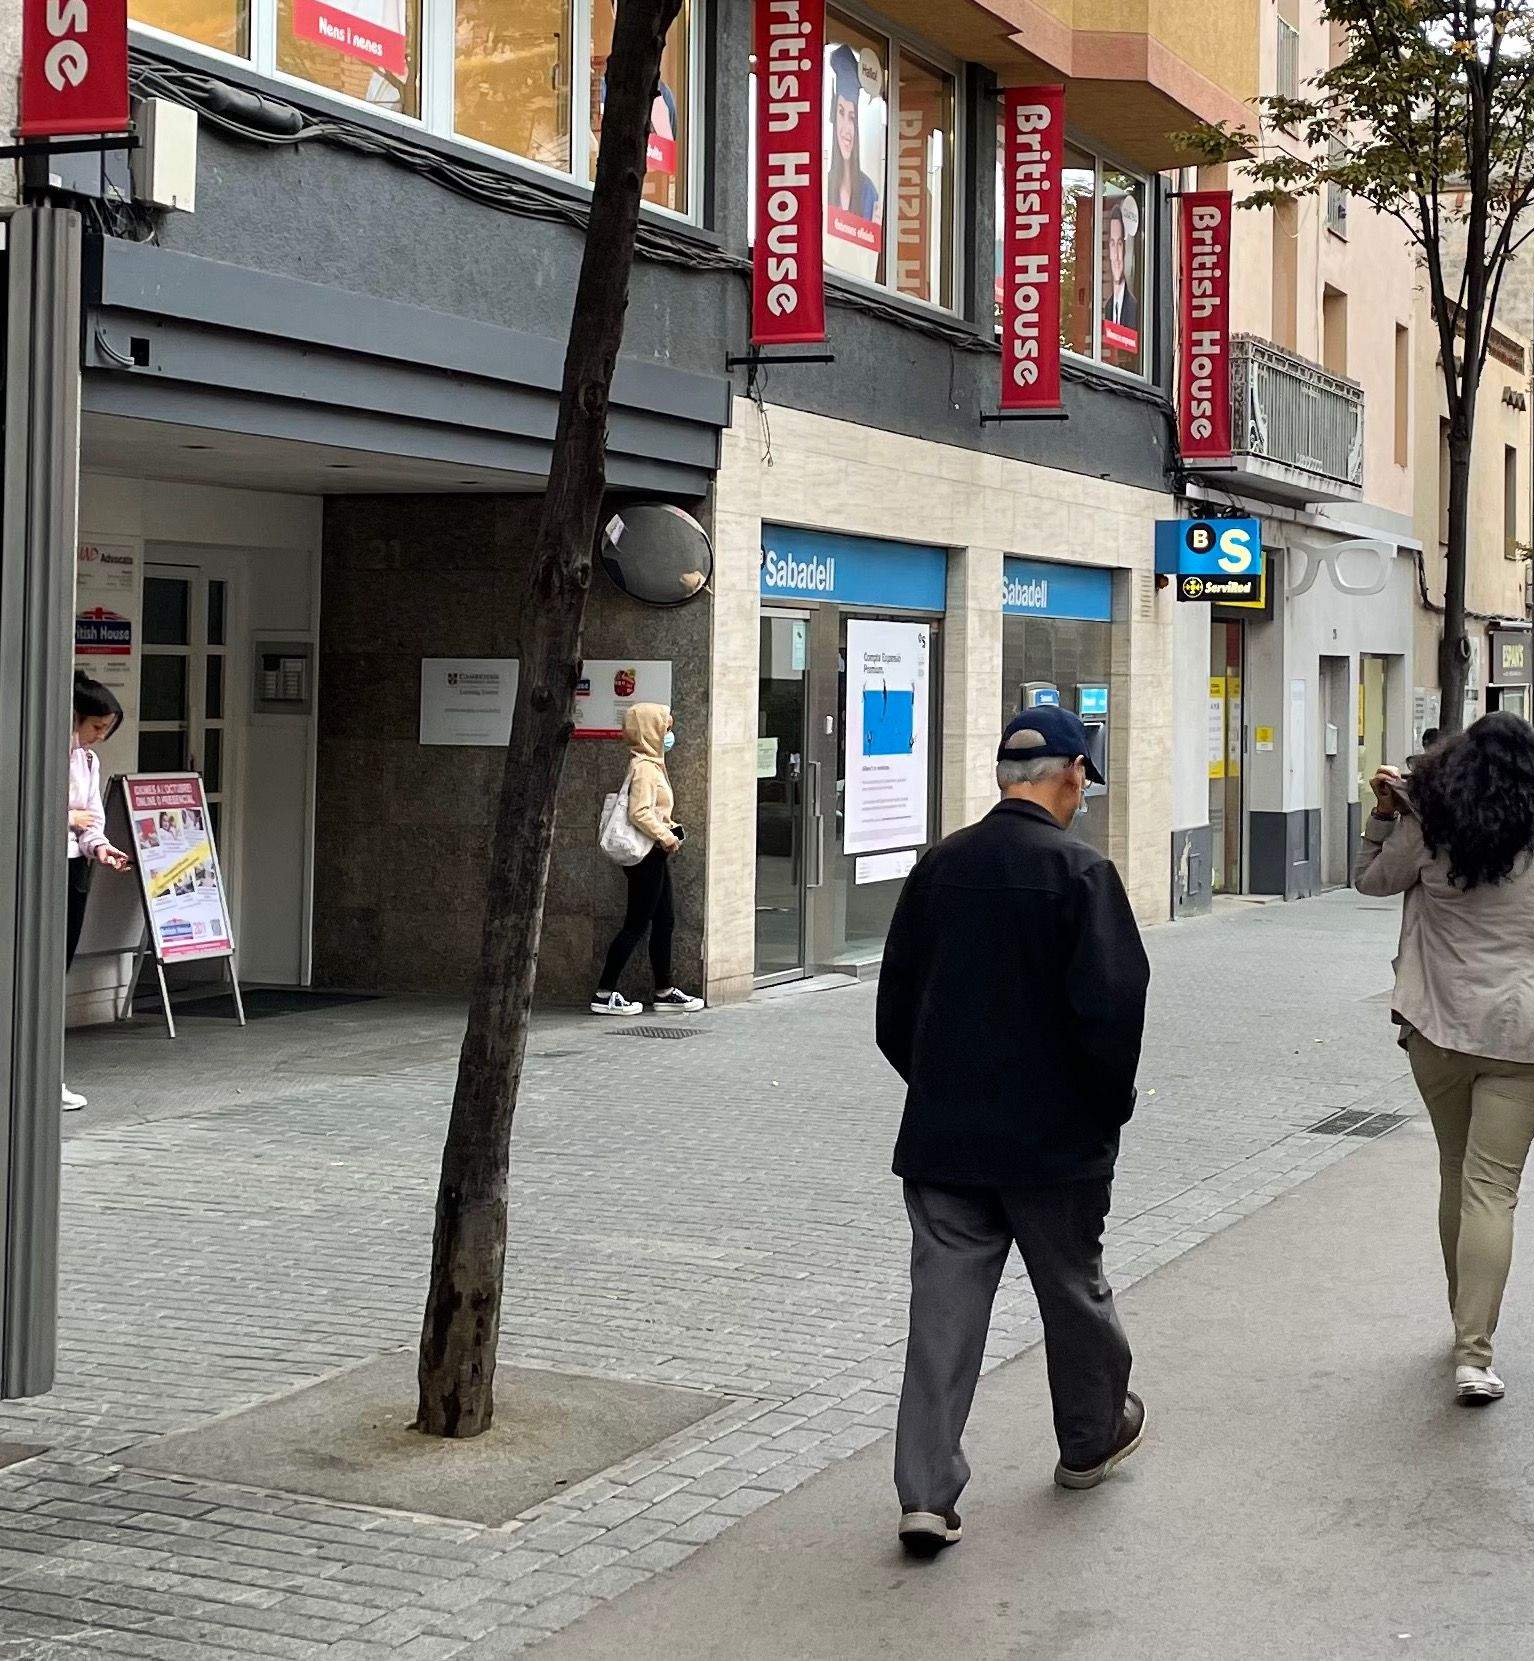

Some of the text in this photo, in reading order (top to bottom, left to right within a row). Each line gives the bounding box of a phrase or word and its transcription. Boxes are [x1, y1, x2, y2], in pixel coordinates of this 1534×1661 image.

[319, 16, 345, 42] Nens
[767, 0, 812, 317] ritish House
[1013, 104, 1051, 387] British House
[1190, 206, 1222, 440] British House
[765, 550, 835, 591] Sabadell
[1193, 528, 1252, 573] B S
[1000, 575, 1048, 608] Sabadell
[1204, 581, 1252, 594] ServiRed
[76, 625, 130, 641] itish House
